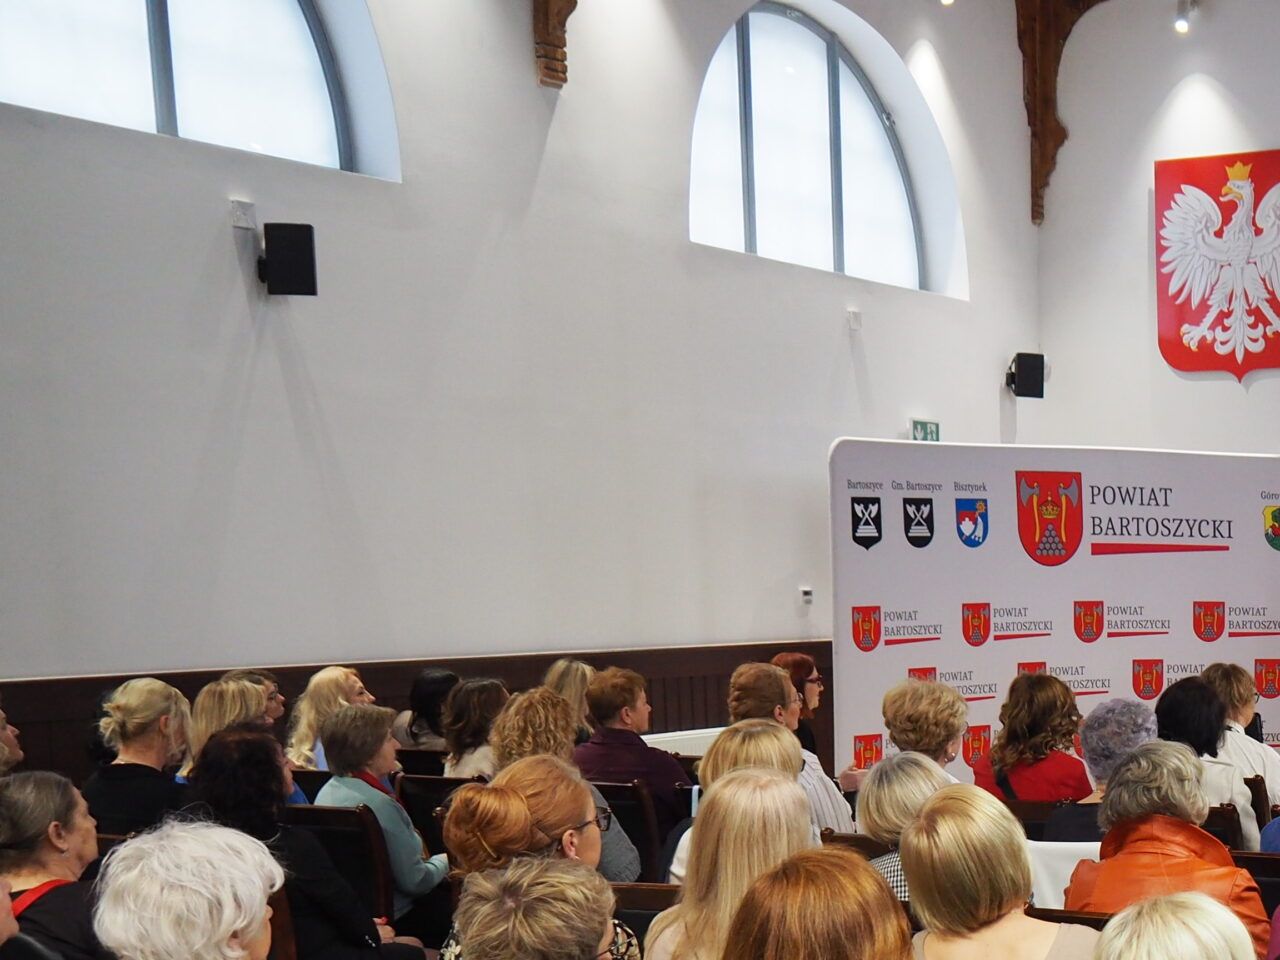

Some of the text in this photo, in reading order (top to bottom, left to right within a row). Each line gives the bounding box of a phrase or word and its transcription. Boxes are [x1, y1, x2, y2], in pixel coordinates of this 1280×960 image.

[847, 479, 883, 492] Bartoszyce
[891, 480, 943, 493] Gm. Bartoszyce
[954, 481, 987, 493] Bisztynek
[1089, 485, 1173, 507] POWIAT
[1090, 516, 1234, 539] BARTOSZYCKI
[884, 610, 918, 621] POWIAT
[993, 607, 1028, 618] POWIAT
[1107, 606, 1144, 616] POWIAT
[1228, 606, 1268, 616] POWIAT
[884, 624, 942, 636] BARTOSZYCKI
[993, 621, 1053, 632] BARTOSZYCKI
[1107, 619, 1171, 630] BARTOSZYCKI
[1050, 666, 1085, 676] POWIAT
[1167, 664, 1205, 674] POWIAT
[939, 671, 973, 682] POWIAT
[1067, 679, 1111, 689] TOSZYCKI
